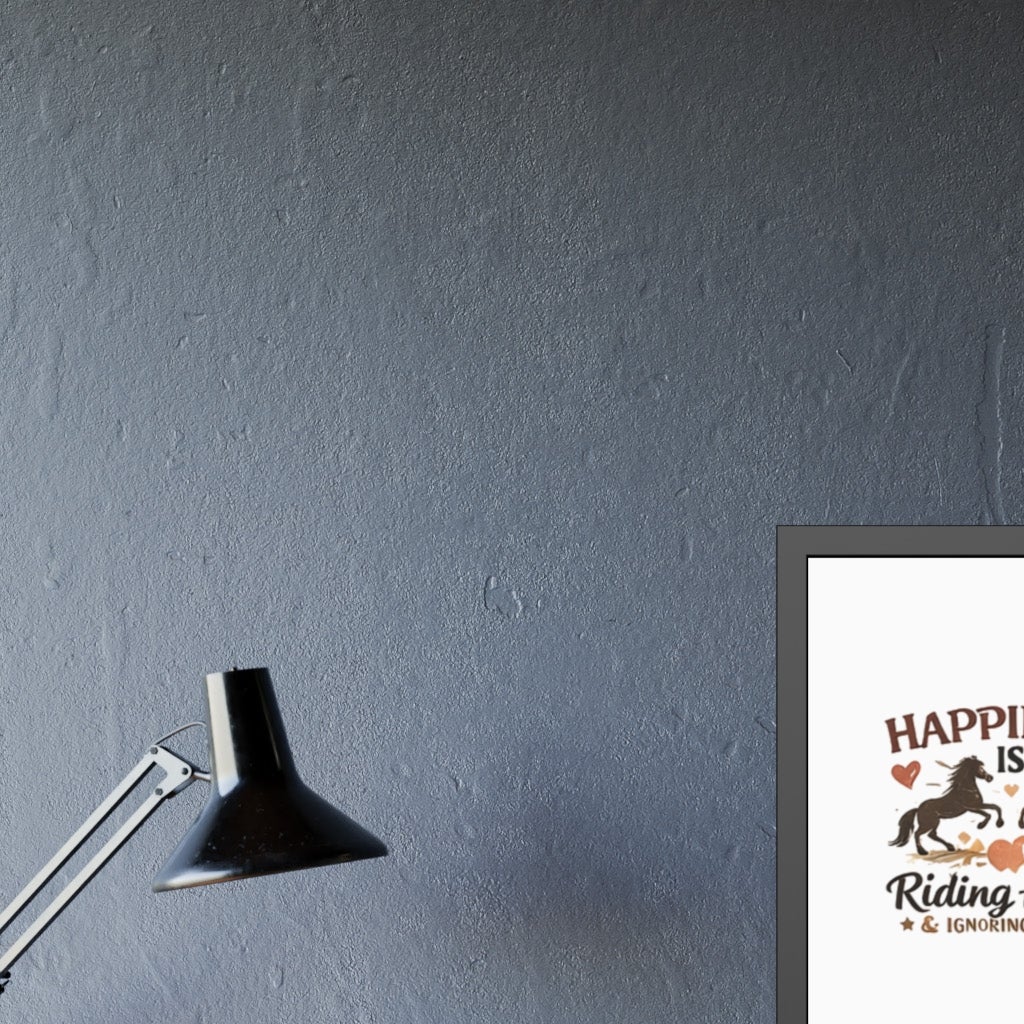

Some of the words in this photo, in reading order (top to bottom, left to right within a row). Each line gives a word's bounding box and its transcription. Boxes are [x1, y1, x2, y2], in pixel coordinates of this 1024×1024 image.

[996, 746, 1024, 773] IS
[886, 872, 1015, 918] Riding
[921, 915, 939, 933] &
